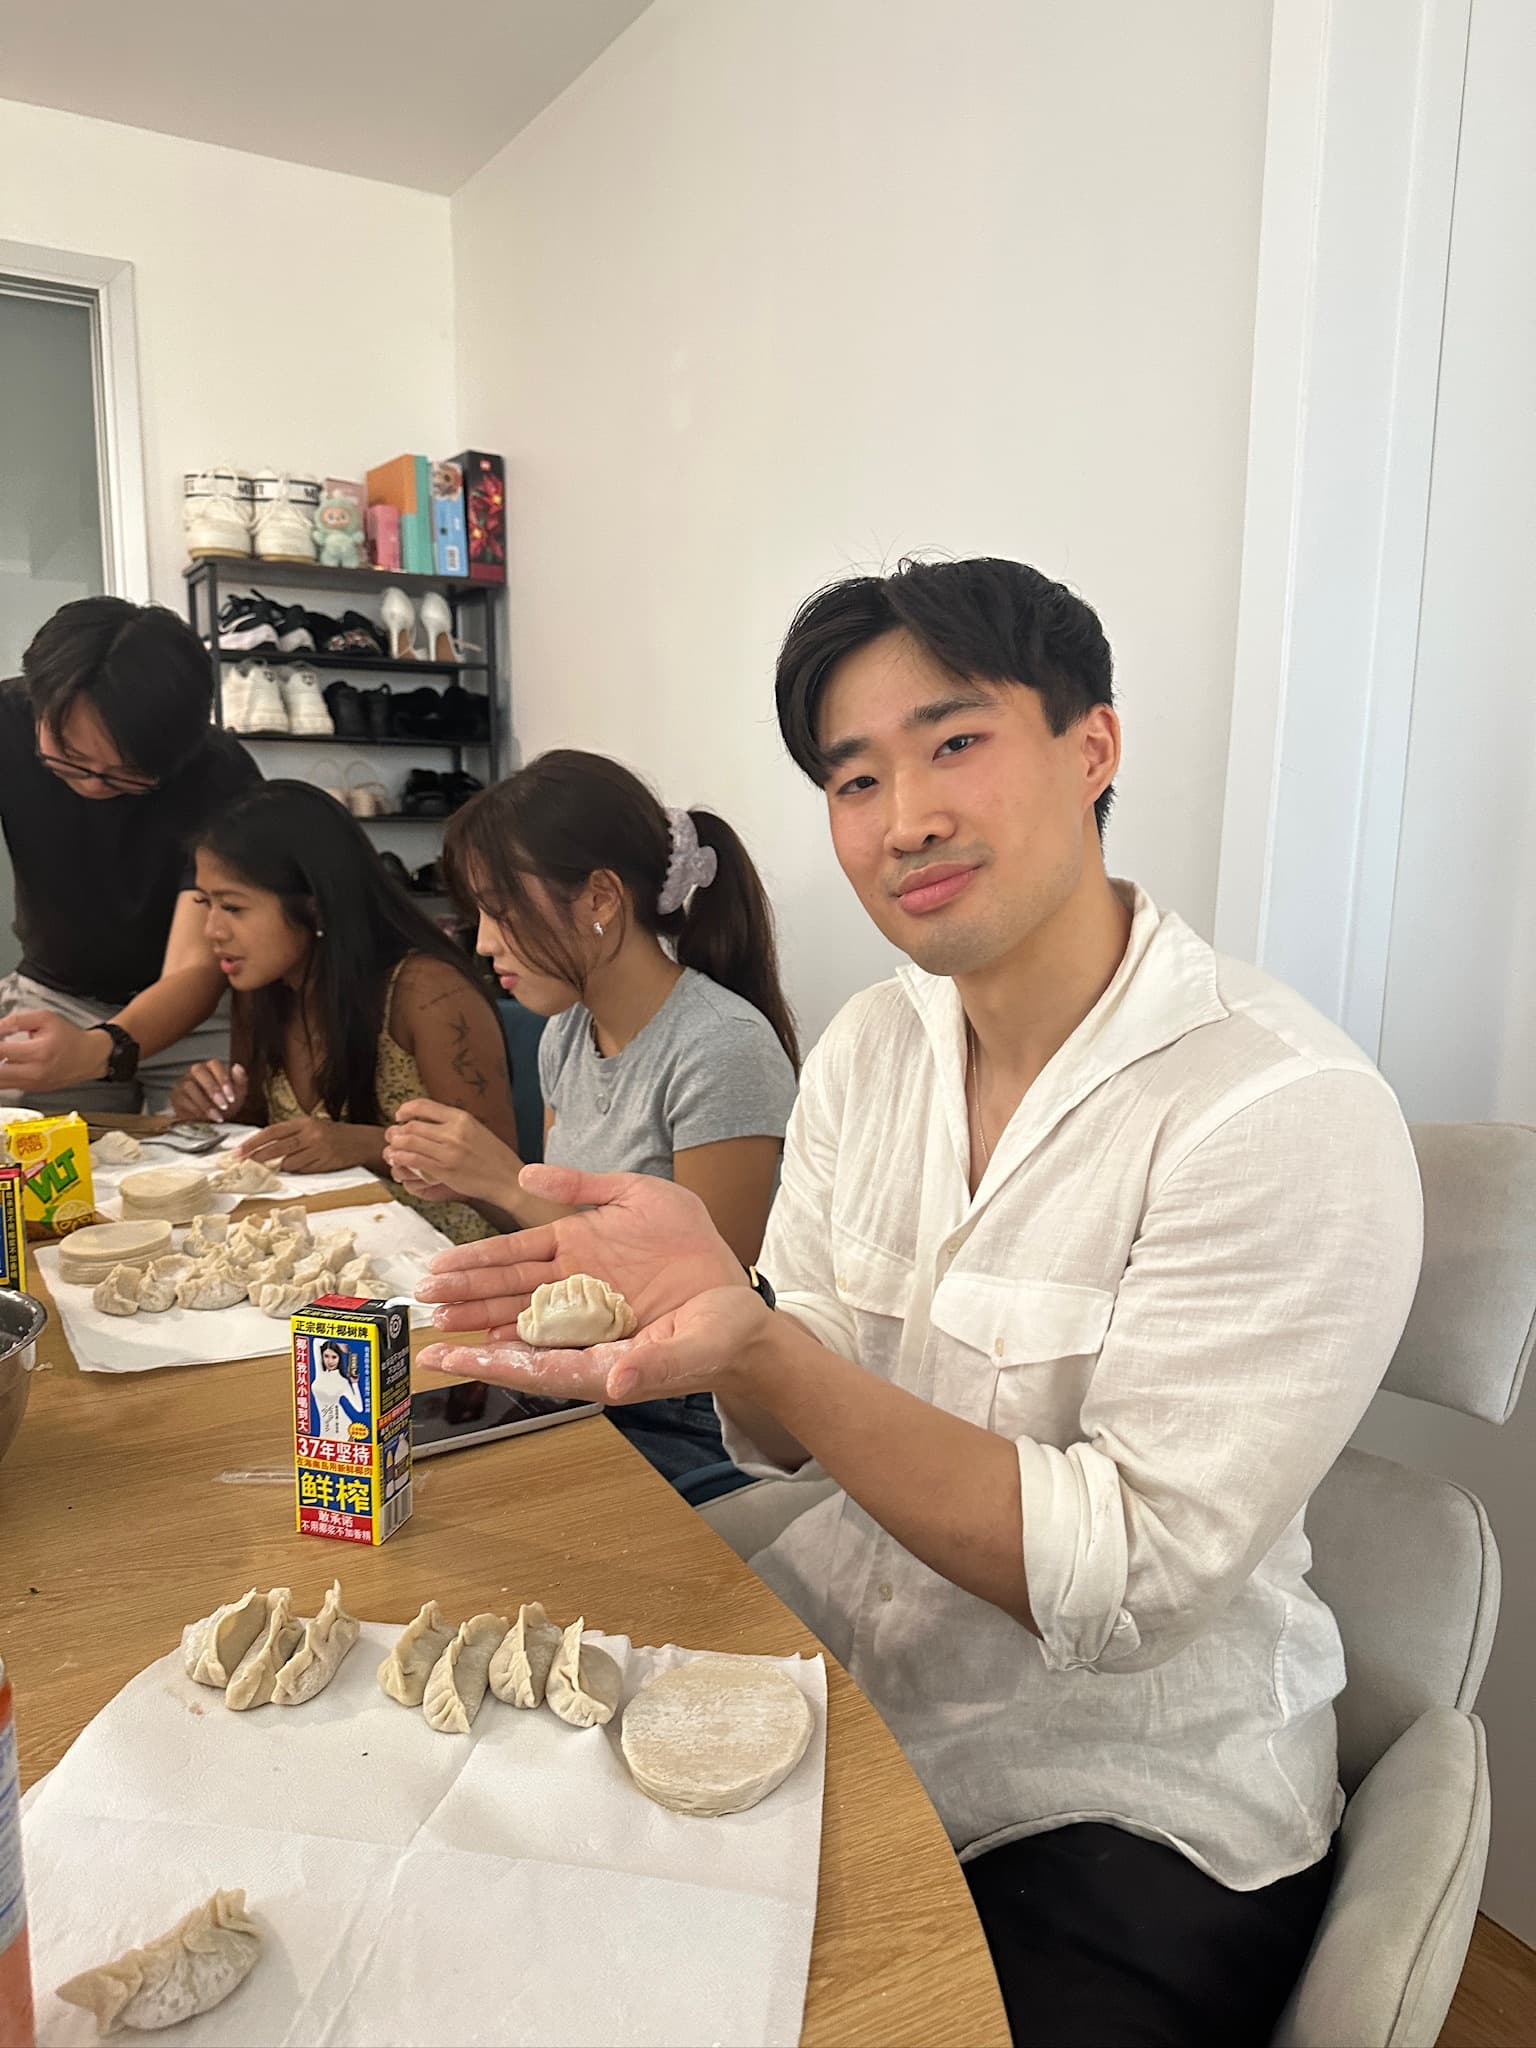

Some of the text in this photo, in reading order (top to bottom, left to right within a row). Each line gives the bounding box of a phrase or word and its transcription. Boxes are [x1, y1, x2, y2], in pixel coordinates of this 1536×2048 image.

[26, 1147, 79, 1204] VLT
[296, 1339, 308, 1432] 椰汁我从小喝到大
[298, 1437, 370, 1465] 37年坚持
[301, 1471, 370, 1513] 鲜榨
[318, 1510, 353, 1528] 敢承诺
